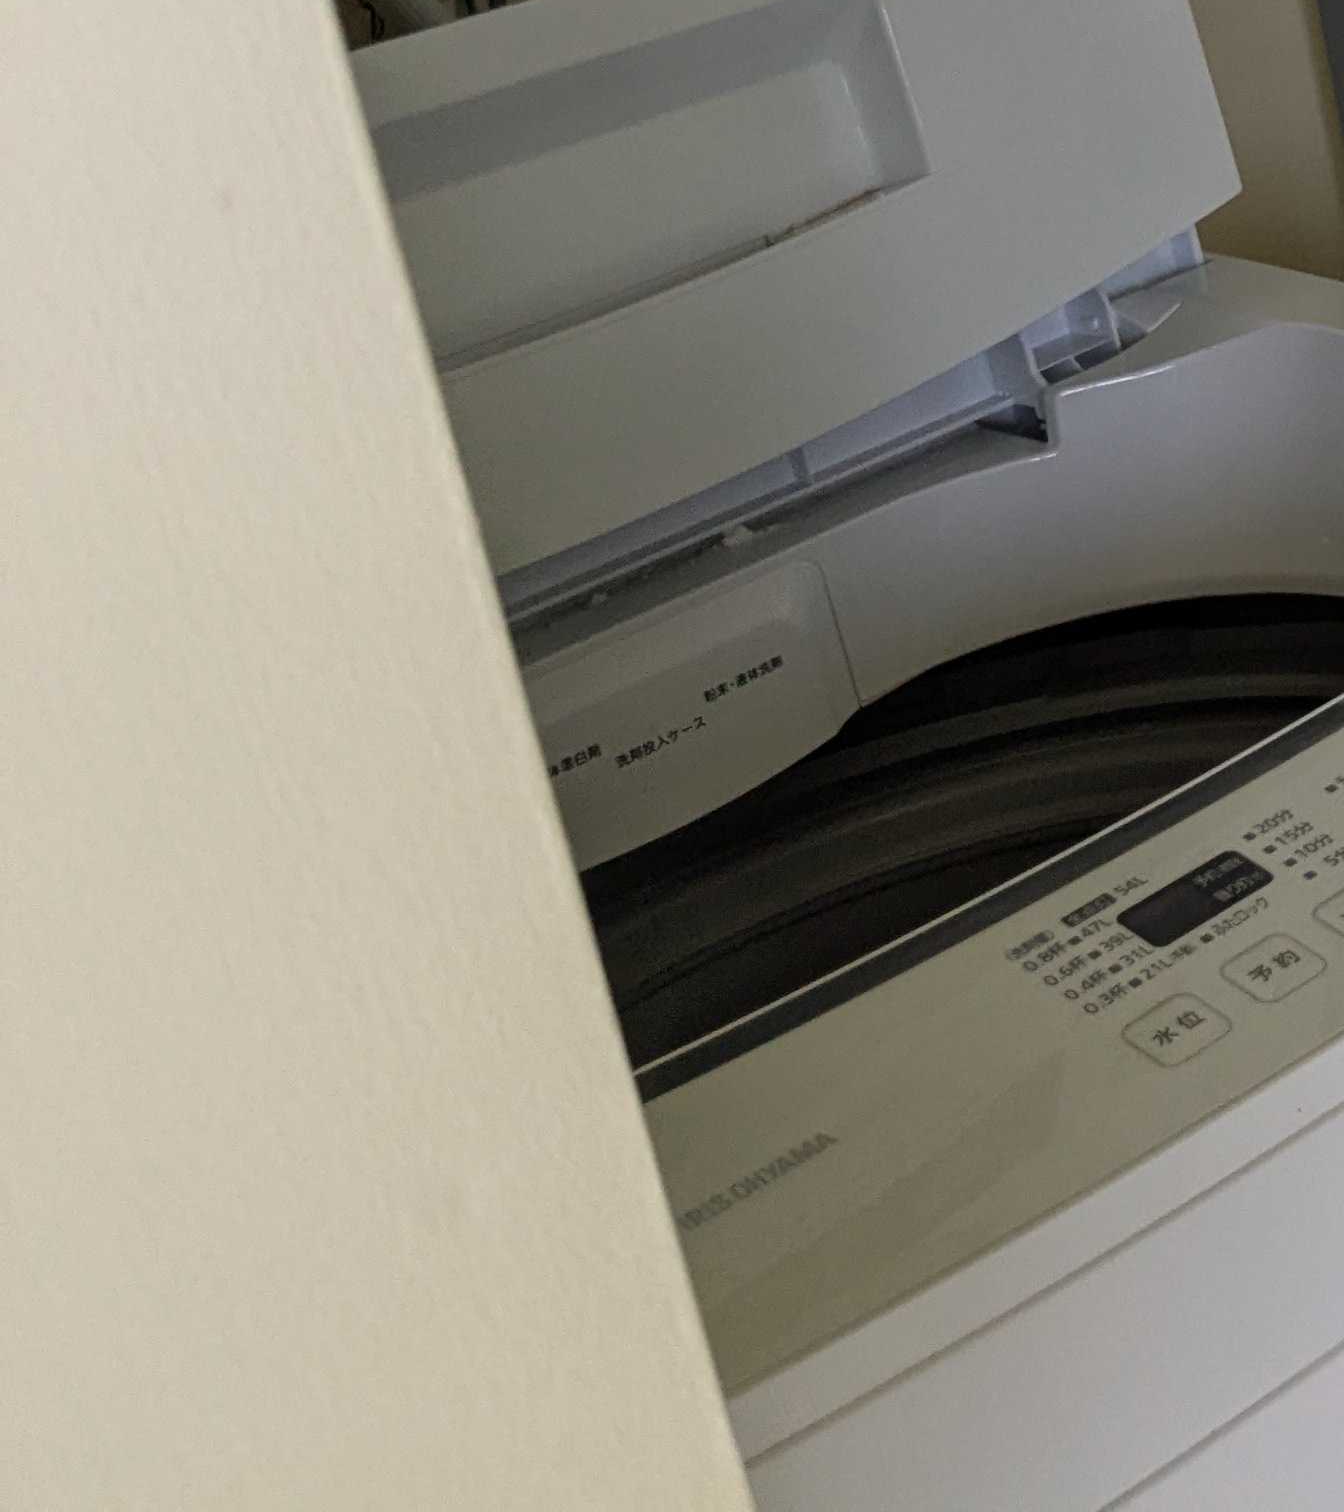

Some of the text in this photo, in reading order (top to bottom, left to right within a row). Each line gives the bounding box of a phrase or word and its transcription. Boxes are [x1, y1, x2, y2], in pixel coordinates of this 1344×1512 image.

[615, 715, 707, 770] 洗剤投入ケース
[1253, 807, 1295, 835] 20分
[1274, 820, 1315, 847] 15分
[1294, 832, 1335, 859] 10分
[1114, 875, 1150, 899] 54L
[1211, 895, 1270, 937] ふたロック
[1022, 941, 1068, 973] 0.8杯
[1081, 916, 1114, 940] 47L
[1042, 931, 1130, 988] 0.6杯 39L
[1063, 968, 1108, 1002] 0.4杯
[1118, 943, 1153, 968] 31L
[1246, 949, 1301, 982] 予約
[1083, 957, 1174, 1016] 0.3杯 21L
[1151, 1009, 1207, 1047] 水位
